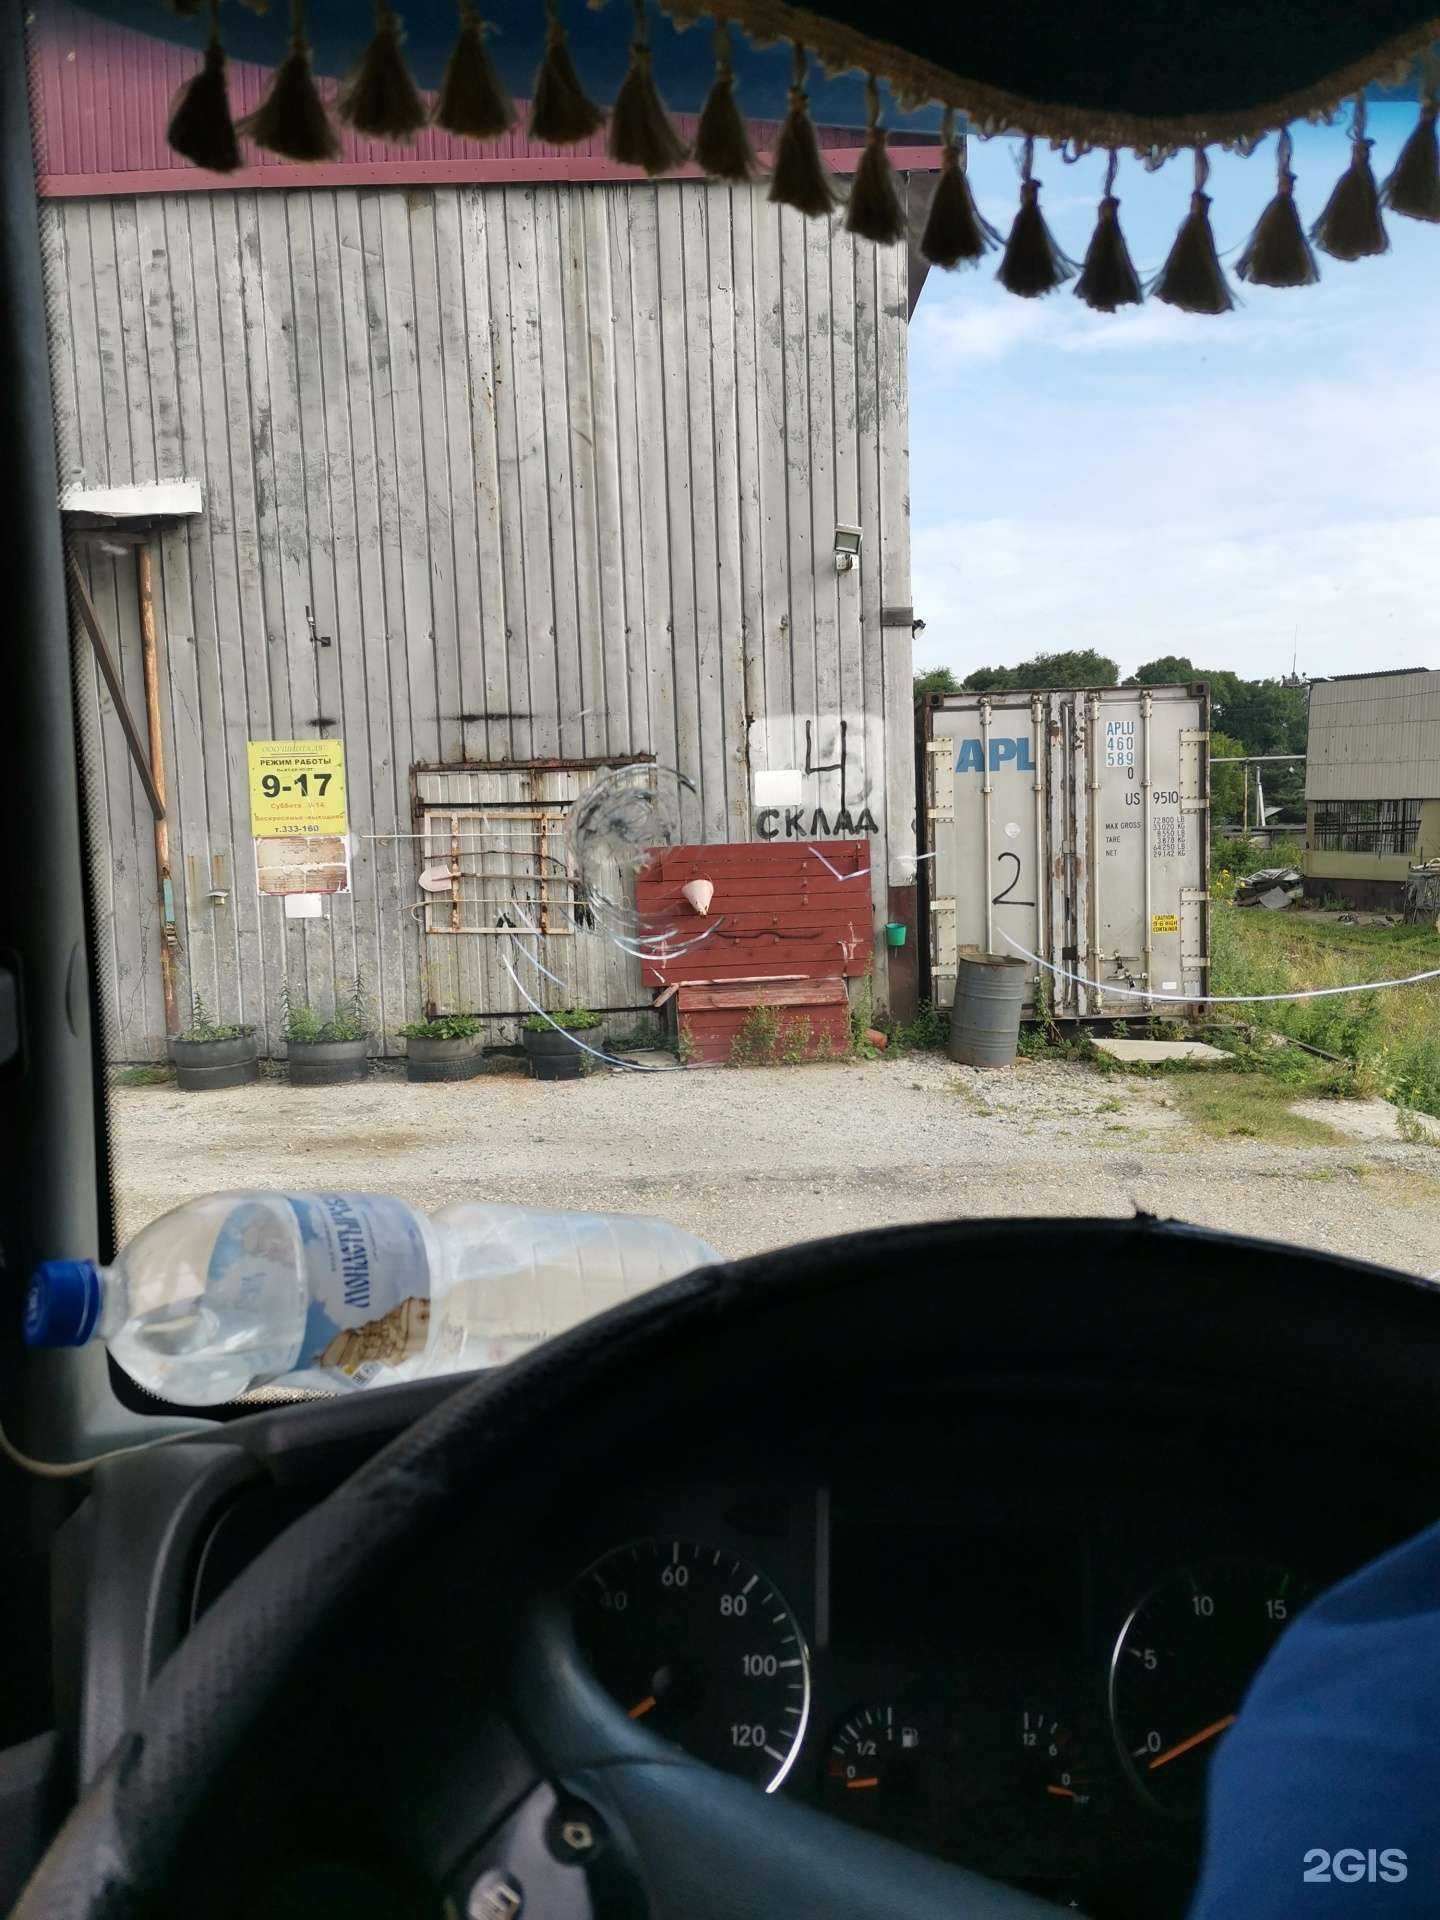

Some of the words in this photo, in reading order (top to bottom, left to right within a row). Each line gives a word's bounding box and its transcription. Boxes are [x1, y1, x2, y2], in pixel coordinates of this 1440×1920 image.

[1107, 721, 1134, 735] APLU
[1107, 737, 1133, 751] 460
[955, 737, 1036, 773] APL
[1107, 752, 1133, 766] 589
[1127, 766, 1134, 780] 0
[261, 773, 332, 798] 9-17
[1125, 792, 1140, 806] US
[1153, 791, 1179, 804] 9510
[1120, 821, 1142, 829] GROSS
[1105, 849, 1117, 857] NET
[992, 852, 1035, 907] 2
[661, 1565, 689, 1587] 60
[720, 1594, 748, 1616] 80
[1191, 1595, 1215, 1617] 10
[1264, 1599, 1288, 1620] 15
[741, 1653, 777, 1677] 100
[1143, 1649, 1158, 1671] 5
[730, 1724, 766, 1747] 120
[1023, 1732, 1038, 1747] 12
[1146, 1730, 1161, 1752] 0
[857, 1741, 877, 1756] 1/2
[1047, 1743, 1058, 1757] 6
[847, 1765, 856, 1779] 0
